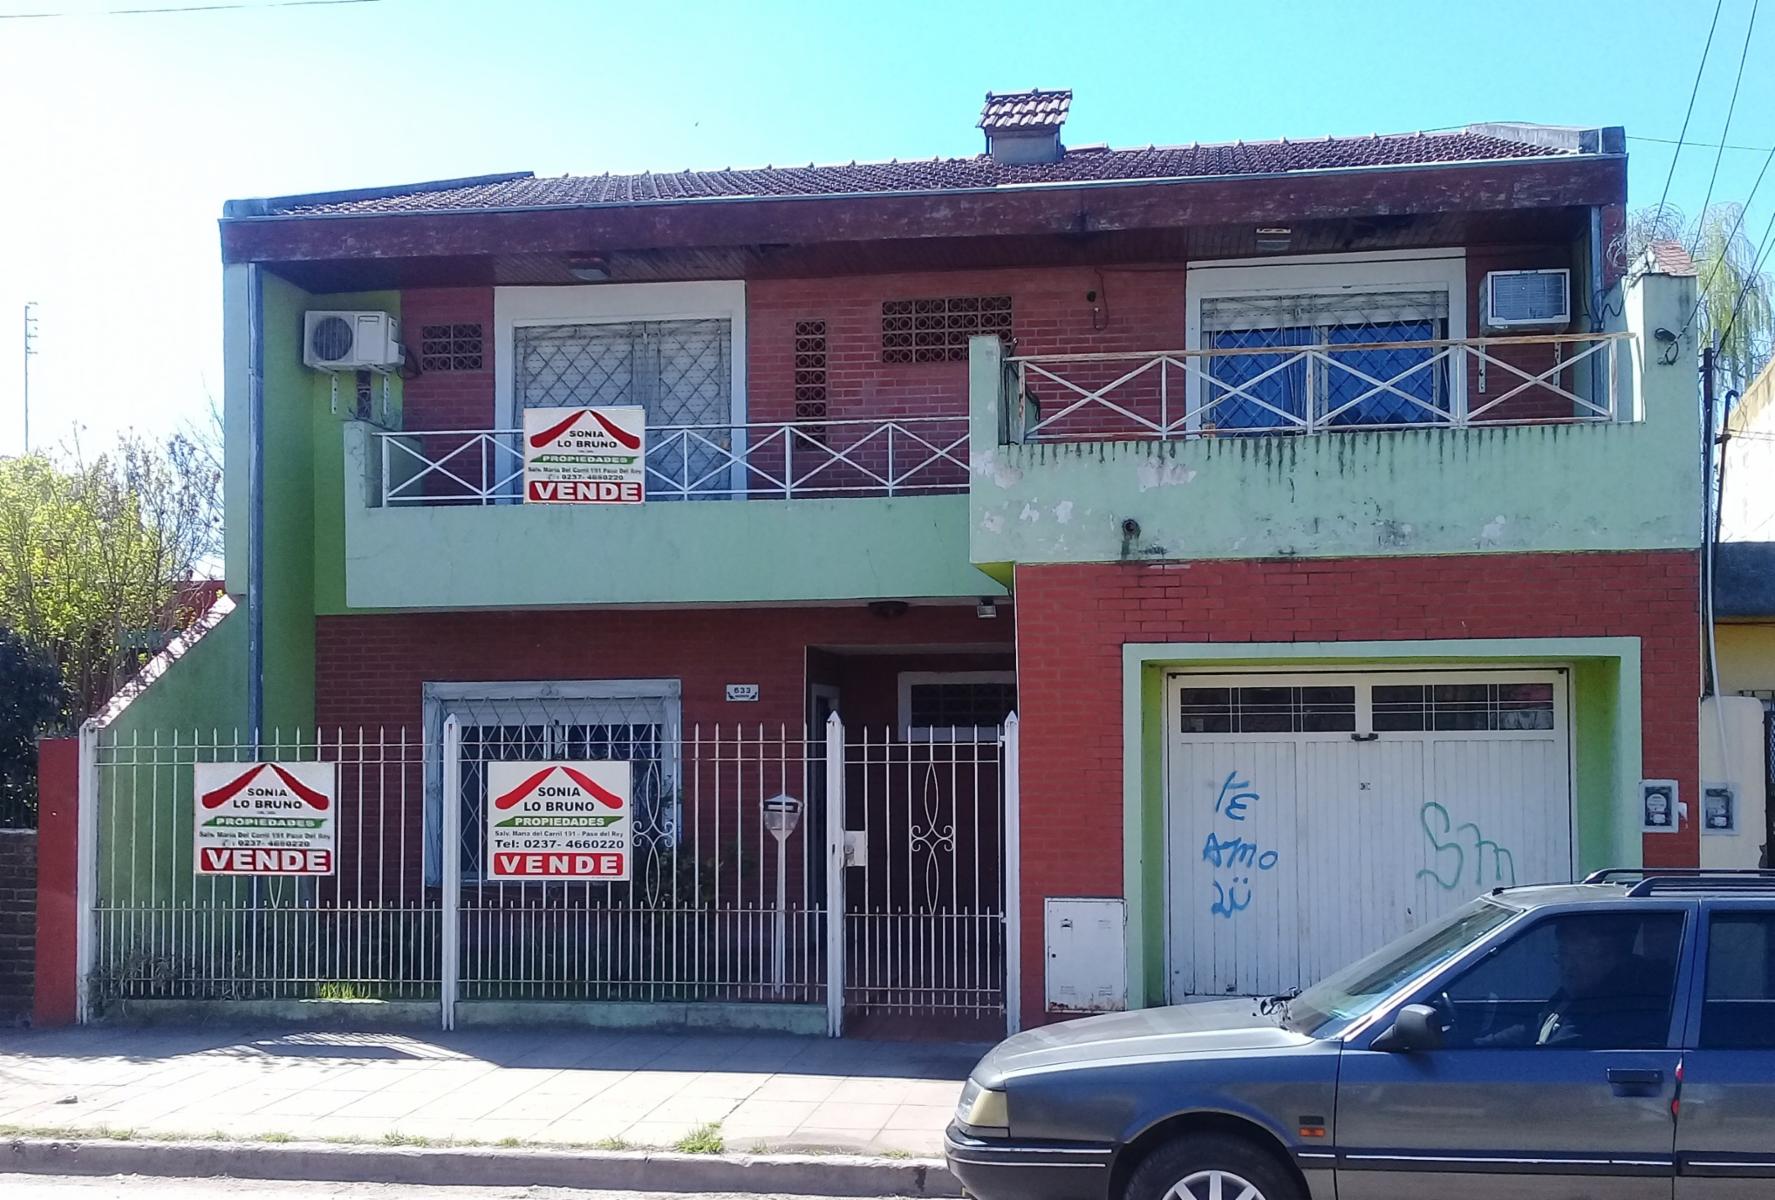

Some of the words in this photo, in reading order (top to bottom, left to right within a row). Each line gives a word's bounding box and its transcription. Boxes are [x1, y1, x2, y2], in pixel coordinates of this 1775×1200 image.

[569, 430, 604, 438] SONIA
[557, 440, 572, 448] LO
[576, 440, 618, 448] BRUNO
[542, 455, 628, 463] PROPIEDADES
[534, 482, 639, 500] VENDE
[247, 788, 288, 797] SONIA
[538, 787, 581, 797] SONIA
[233, 800, 250, 809] LO
[255, 800, 303, 810] BRUNO
[524, 801, 541, 811] LO
[546, 801, 595, 811] BRUNO
[216, 818, 315, 827] PROPIEDADES
[514, 817, 605, 827] PROPIEDADES
[611, 830, 624, 838] Rey
[495, 839, 520, 848] Tel:
[523, 839, 562, 848] 0237-
[565, 839, 624, 849] 4660220
[206, 849, 328, 871] VENDE
[500, 855, 618, 874] VENDE
